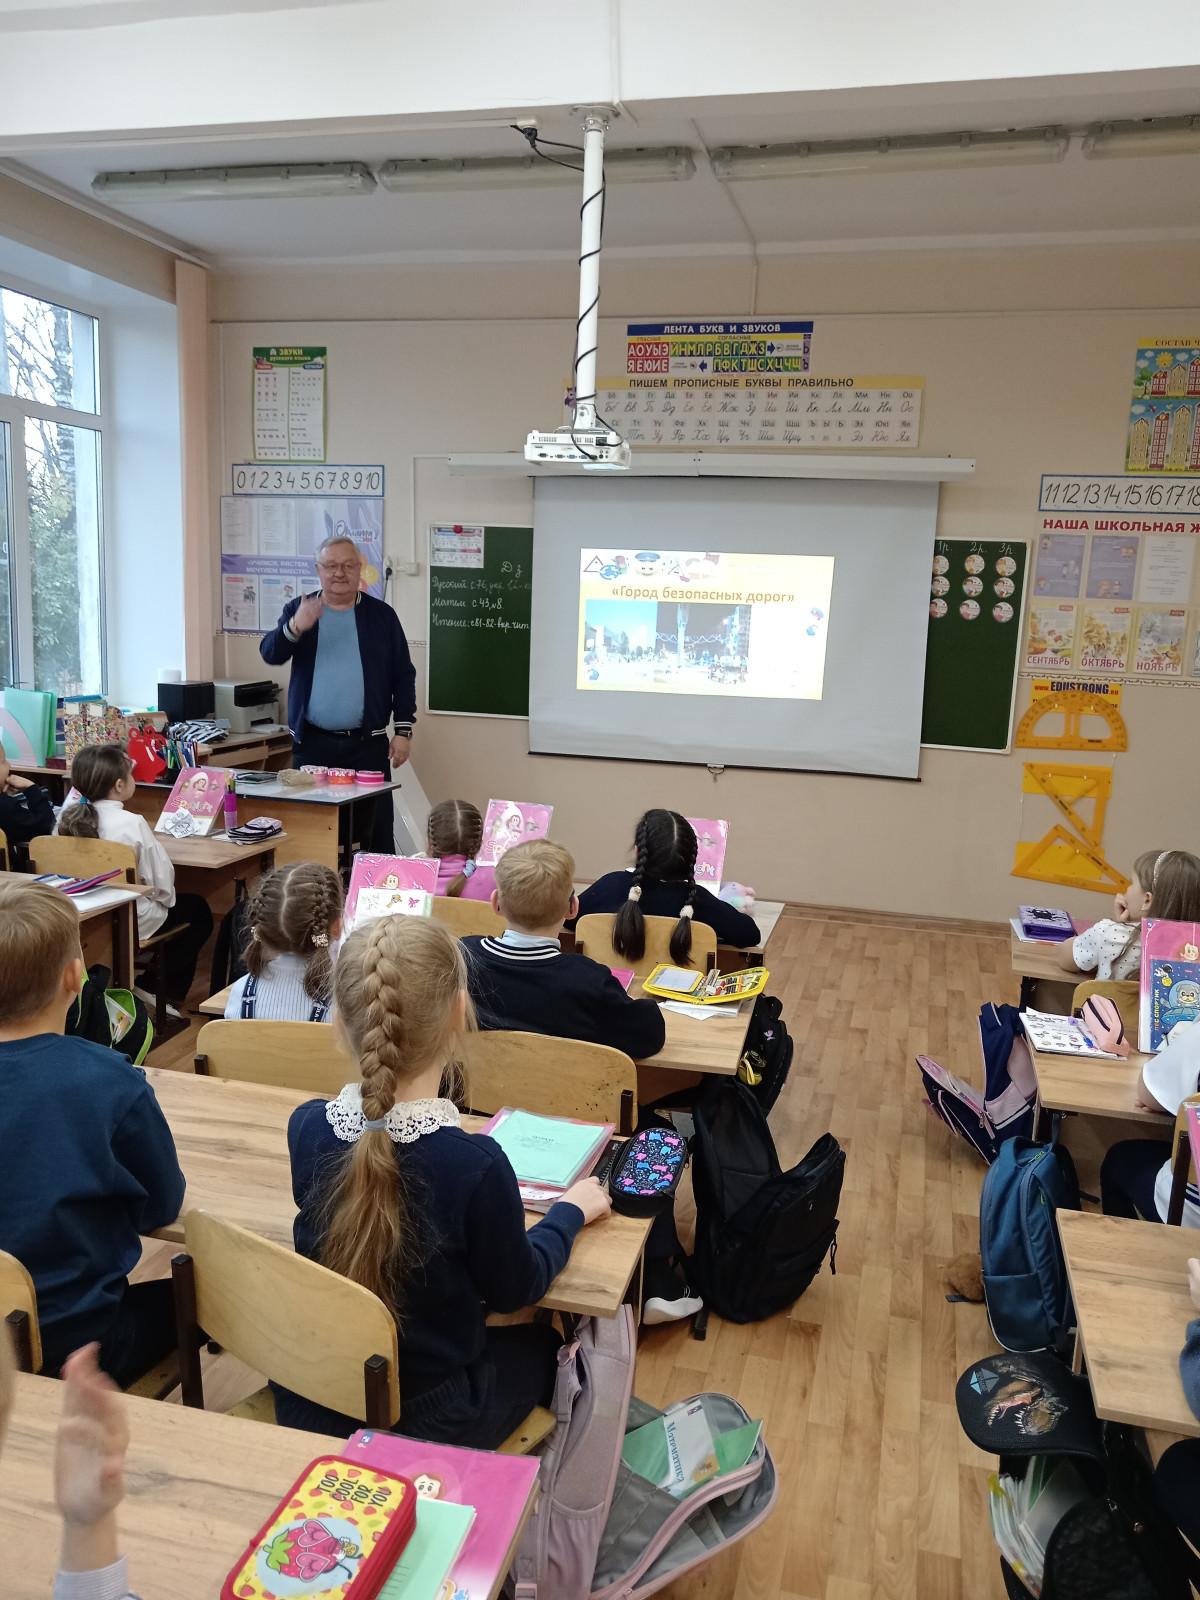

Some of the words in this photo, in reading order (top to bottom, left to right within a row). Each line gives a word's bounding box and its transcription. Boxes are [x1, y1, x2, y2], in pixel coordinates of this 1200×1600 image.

[664, 325, 694, 333] ЛЕНТА
[700, 325, 724, 333] БУКВ
[742, 324, 781, 332] ЗВУКОВ
[629, 379, 668, 388] ПИШЕМ
[673, 379, 739, 387] ПРОПИСНЫЕ
[745, 379, 782, 387] БУКВЫ
[788, 378, 854, 387] ПРАВИЛЬНО
[236, 471, 246, 488] 0
[250, 471, 256, 488] 1
[259, 471, 269, 489] 2
[273, 471, 283, 488] 3
[286, 472, 295, 489] 4
[300, 472, 310, 489] 5
[314, 472, 324, 489] 6
[327, 472, 337, 489] 7
[339, 472, 350, 490] 8
[352, 472, 363, 490] 9
[365, 472, 380, 490] 10
[1045, 483, 1061, 503] 11
[1062, 483, 1081, 504] 12
[1083, 484, 1101, 504] 13
[1104, 484, 1121, 504] 14
[1124, 484, 1143, 505] 15
[1145, 485, 1164, 505] 16
[1166, 485, 1185, 506] 17
[1043, 519, 1089, 530] НАША
[1094, 520, 1185, 533] ШКОЛЬНАЯ
[612, 585, 659, 600] «Город
[662, 586, 742, 602] безопасных
[745, 591, 795, 604] дорог»
[1027, 655, 1070, 666] СЕНТЯБРЬ
[1081, 658, 1125, 669] ОКТЯБРЬ
[1136, 662, 1178, 673] НОЯБРЬ
[666, 1421, 685, 1483] Математика
[316, 1474, 339, 1493] TOO
[332, 1478, 359, 1502] COOL
[350, 1485, 373, 1504] FOR
[367, 1486, 392, 1507] YOU
